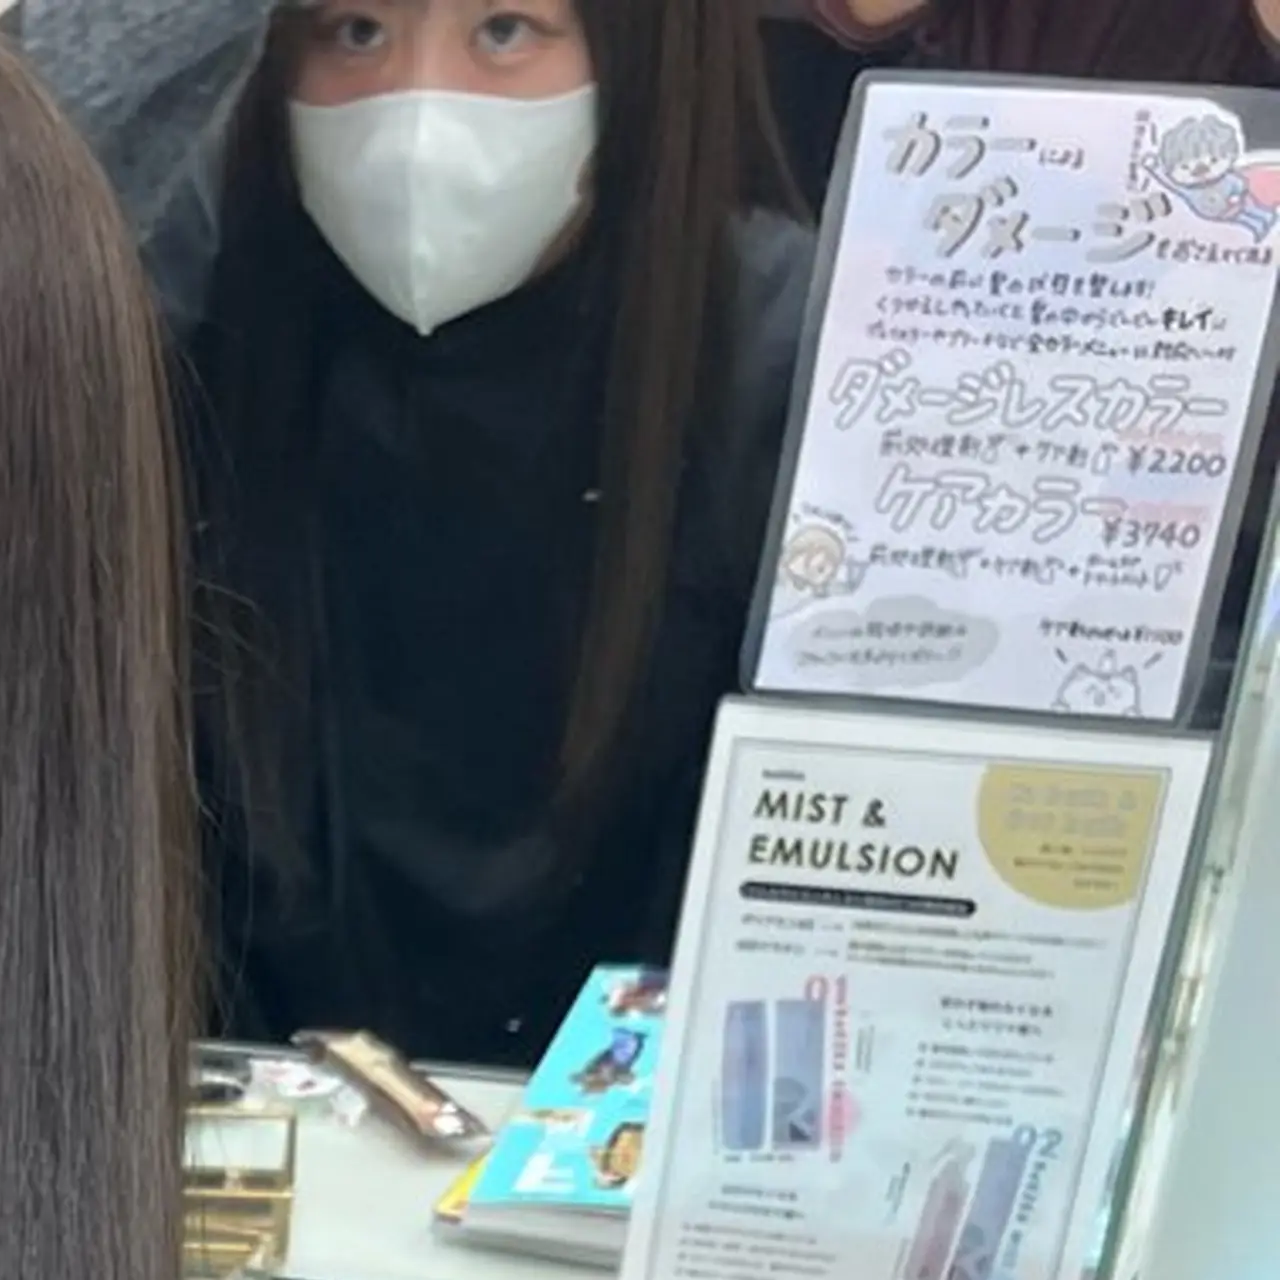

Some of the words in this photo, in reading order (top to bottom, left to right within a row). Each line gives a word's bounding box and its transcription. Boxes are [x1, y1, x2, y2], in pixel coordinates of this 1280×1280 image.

[828, 348, 1230, 431] ダメージレスカラー
[1127, 450, 1228, 478] ¥2200
[874, 461, 1130, 544] ケアカラー
[1103, 514, 1202, 549] ¥3740
[753, 789, 848, 825] MIST
[862, 799, 886, 827] &
[748, 834, 958, 880] EMULSION
[1011, 1124, 1063, 1161] 02
